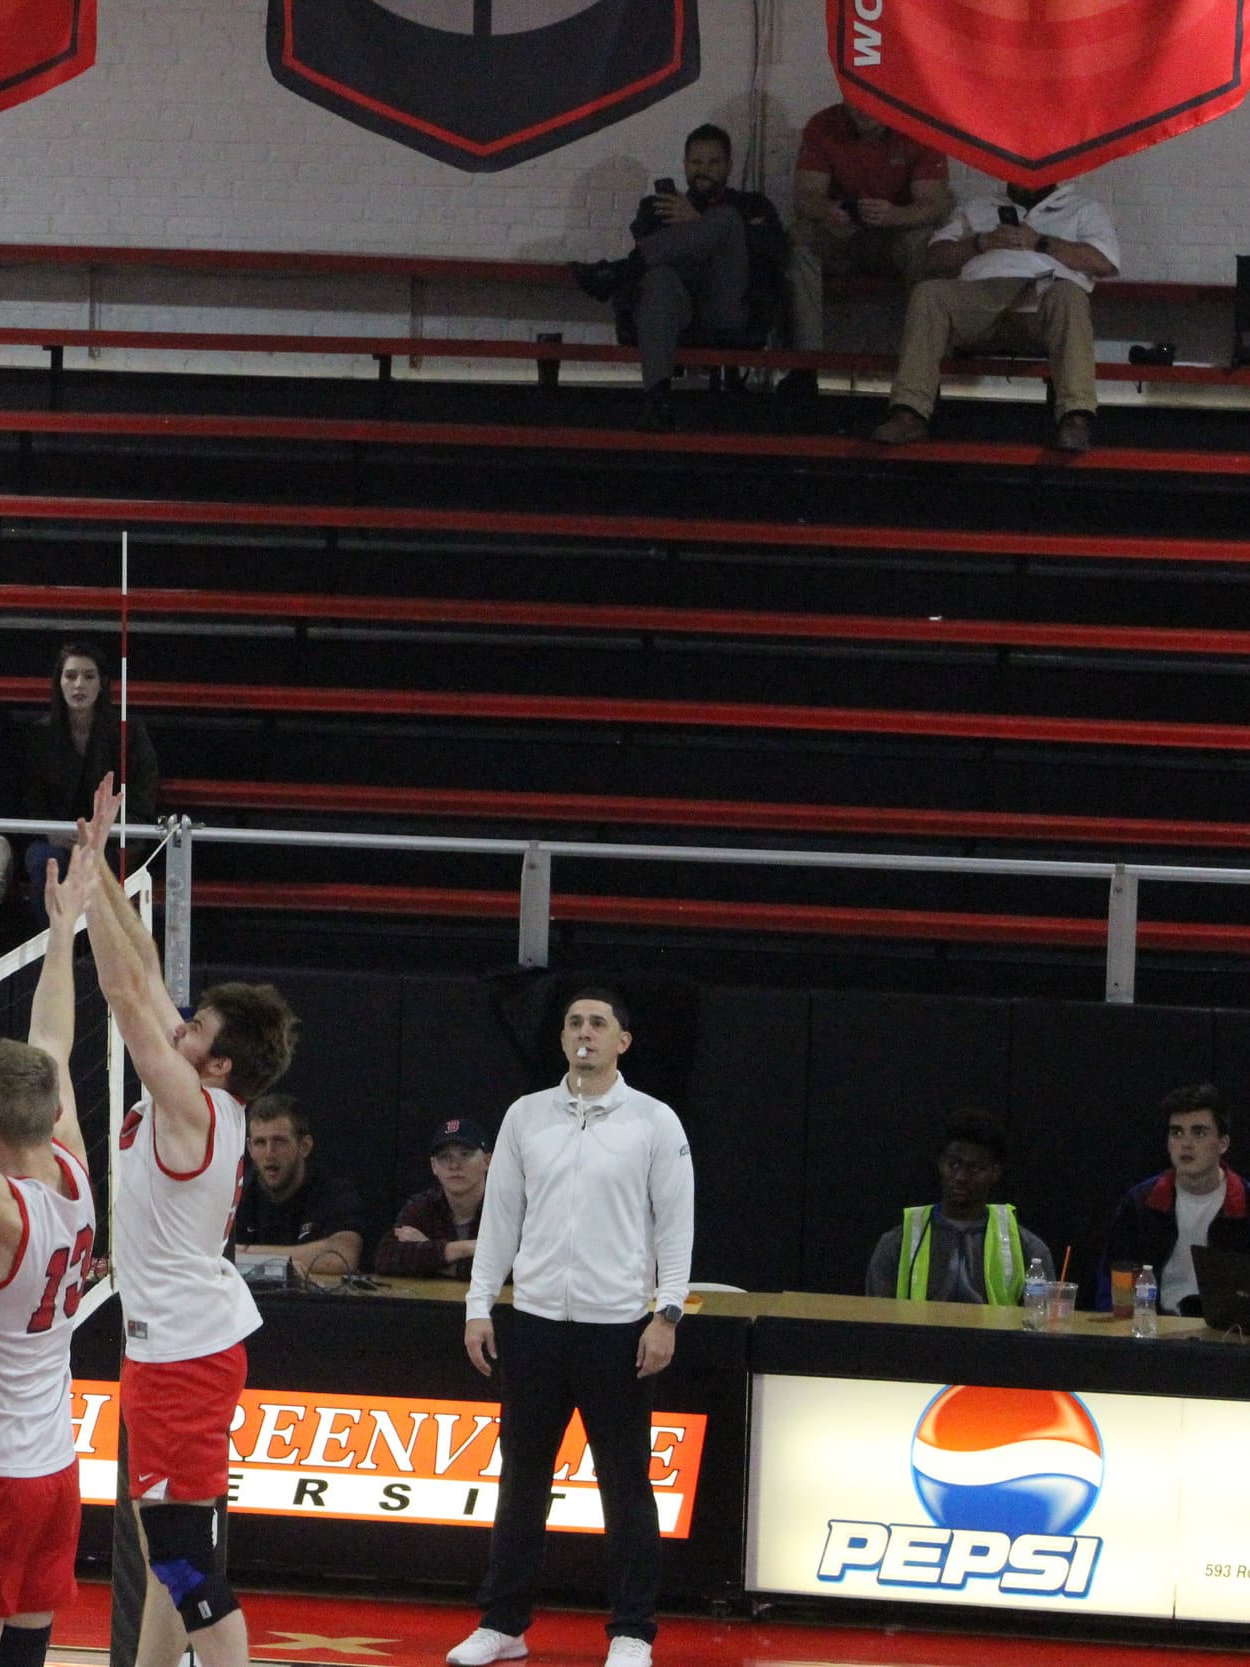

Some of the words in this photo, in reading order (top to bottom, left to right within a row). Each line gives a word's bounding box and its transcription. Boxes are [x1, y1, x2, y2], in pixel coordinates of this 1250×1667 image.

[26, 1223, 95, 1334] 13
[817, 1519, 1103, 1598] PEPSI
[1205, 1563, 1232, 1578] 593
